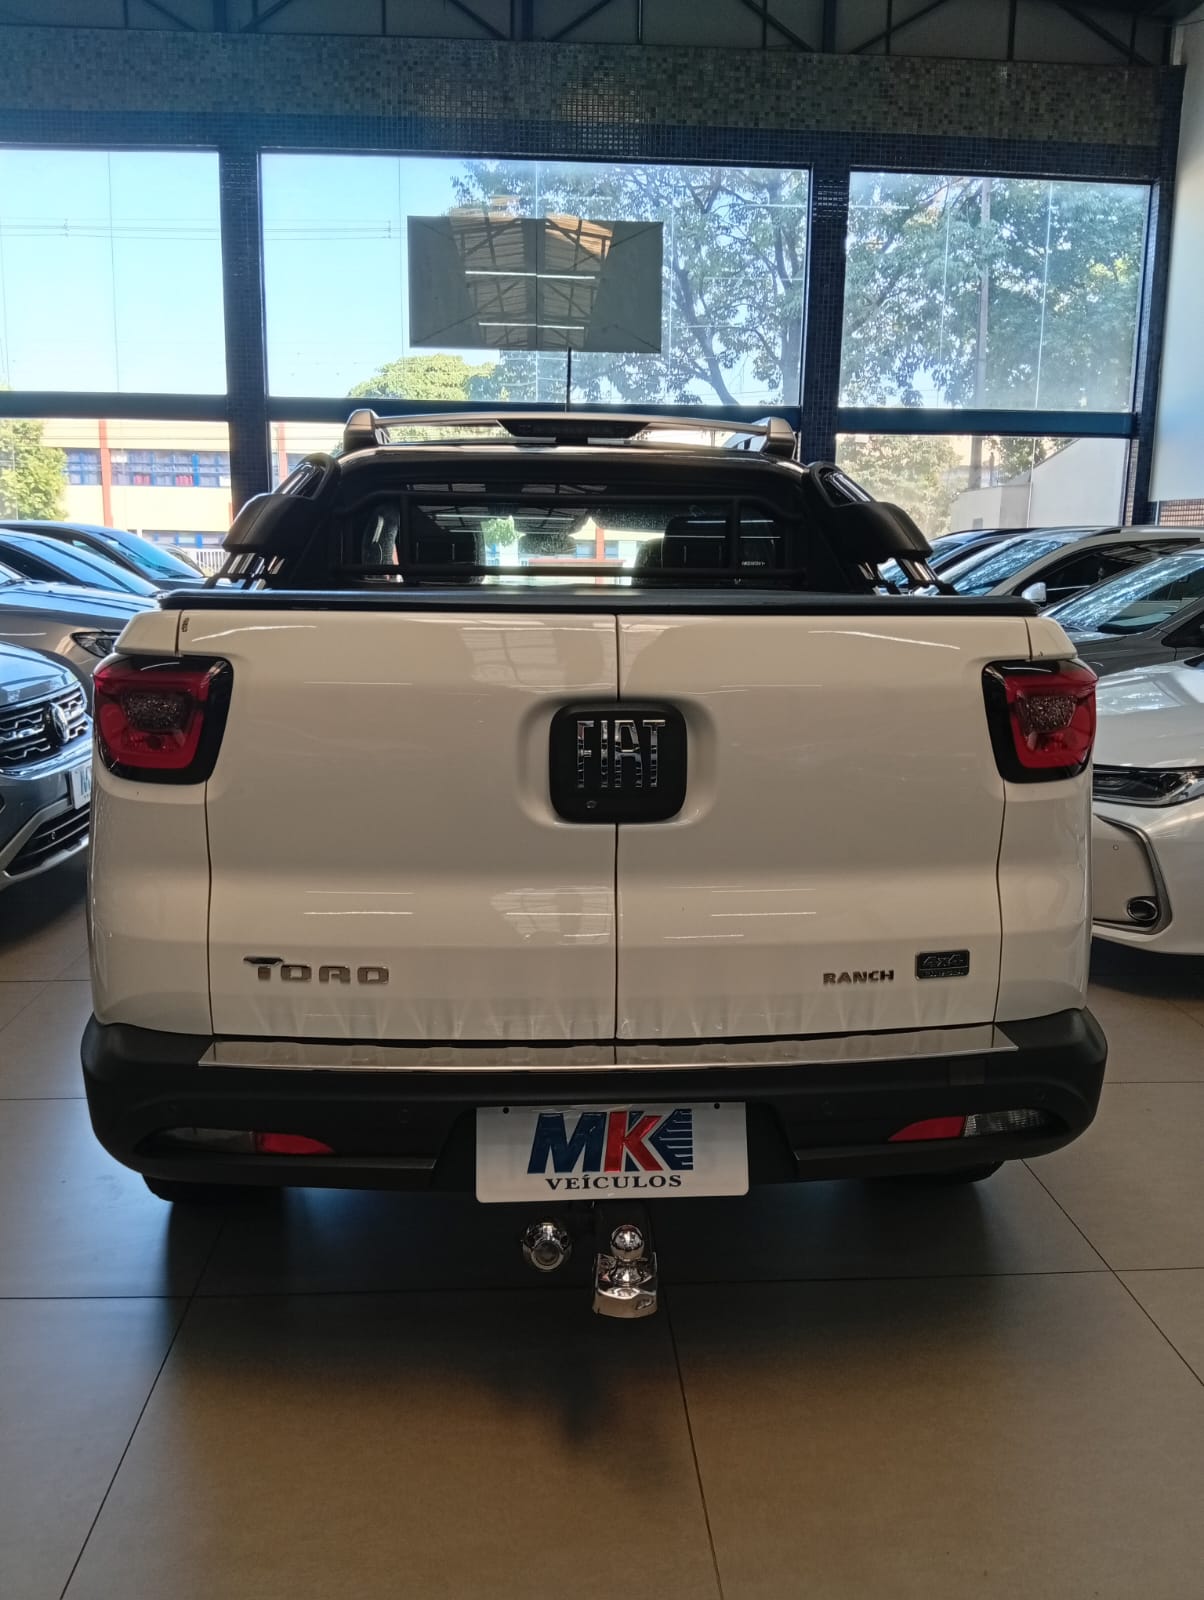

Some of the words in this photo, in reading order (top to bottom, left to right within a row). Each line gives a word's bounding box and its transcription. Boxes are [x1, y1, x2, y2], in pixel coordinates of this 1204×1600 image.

[577, 719, 665, 788] FIAT
[243, 956, 389, 984] TORO
[823, 969, 894, 985] RANCH
[545, 1174, 682, 1190] VEÍCULOS
